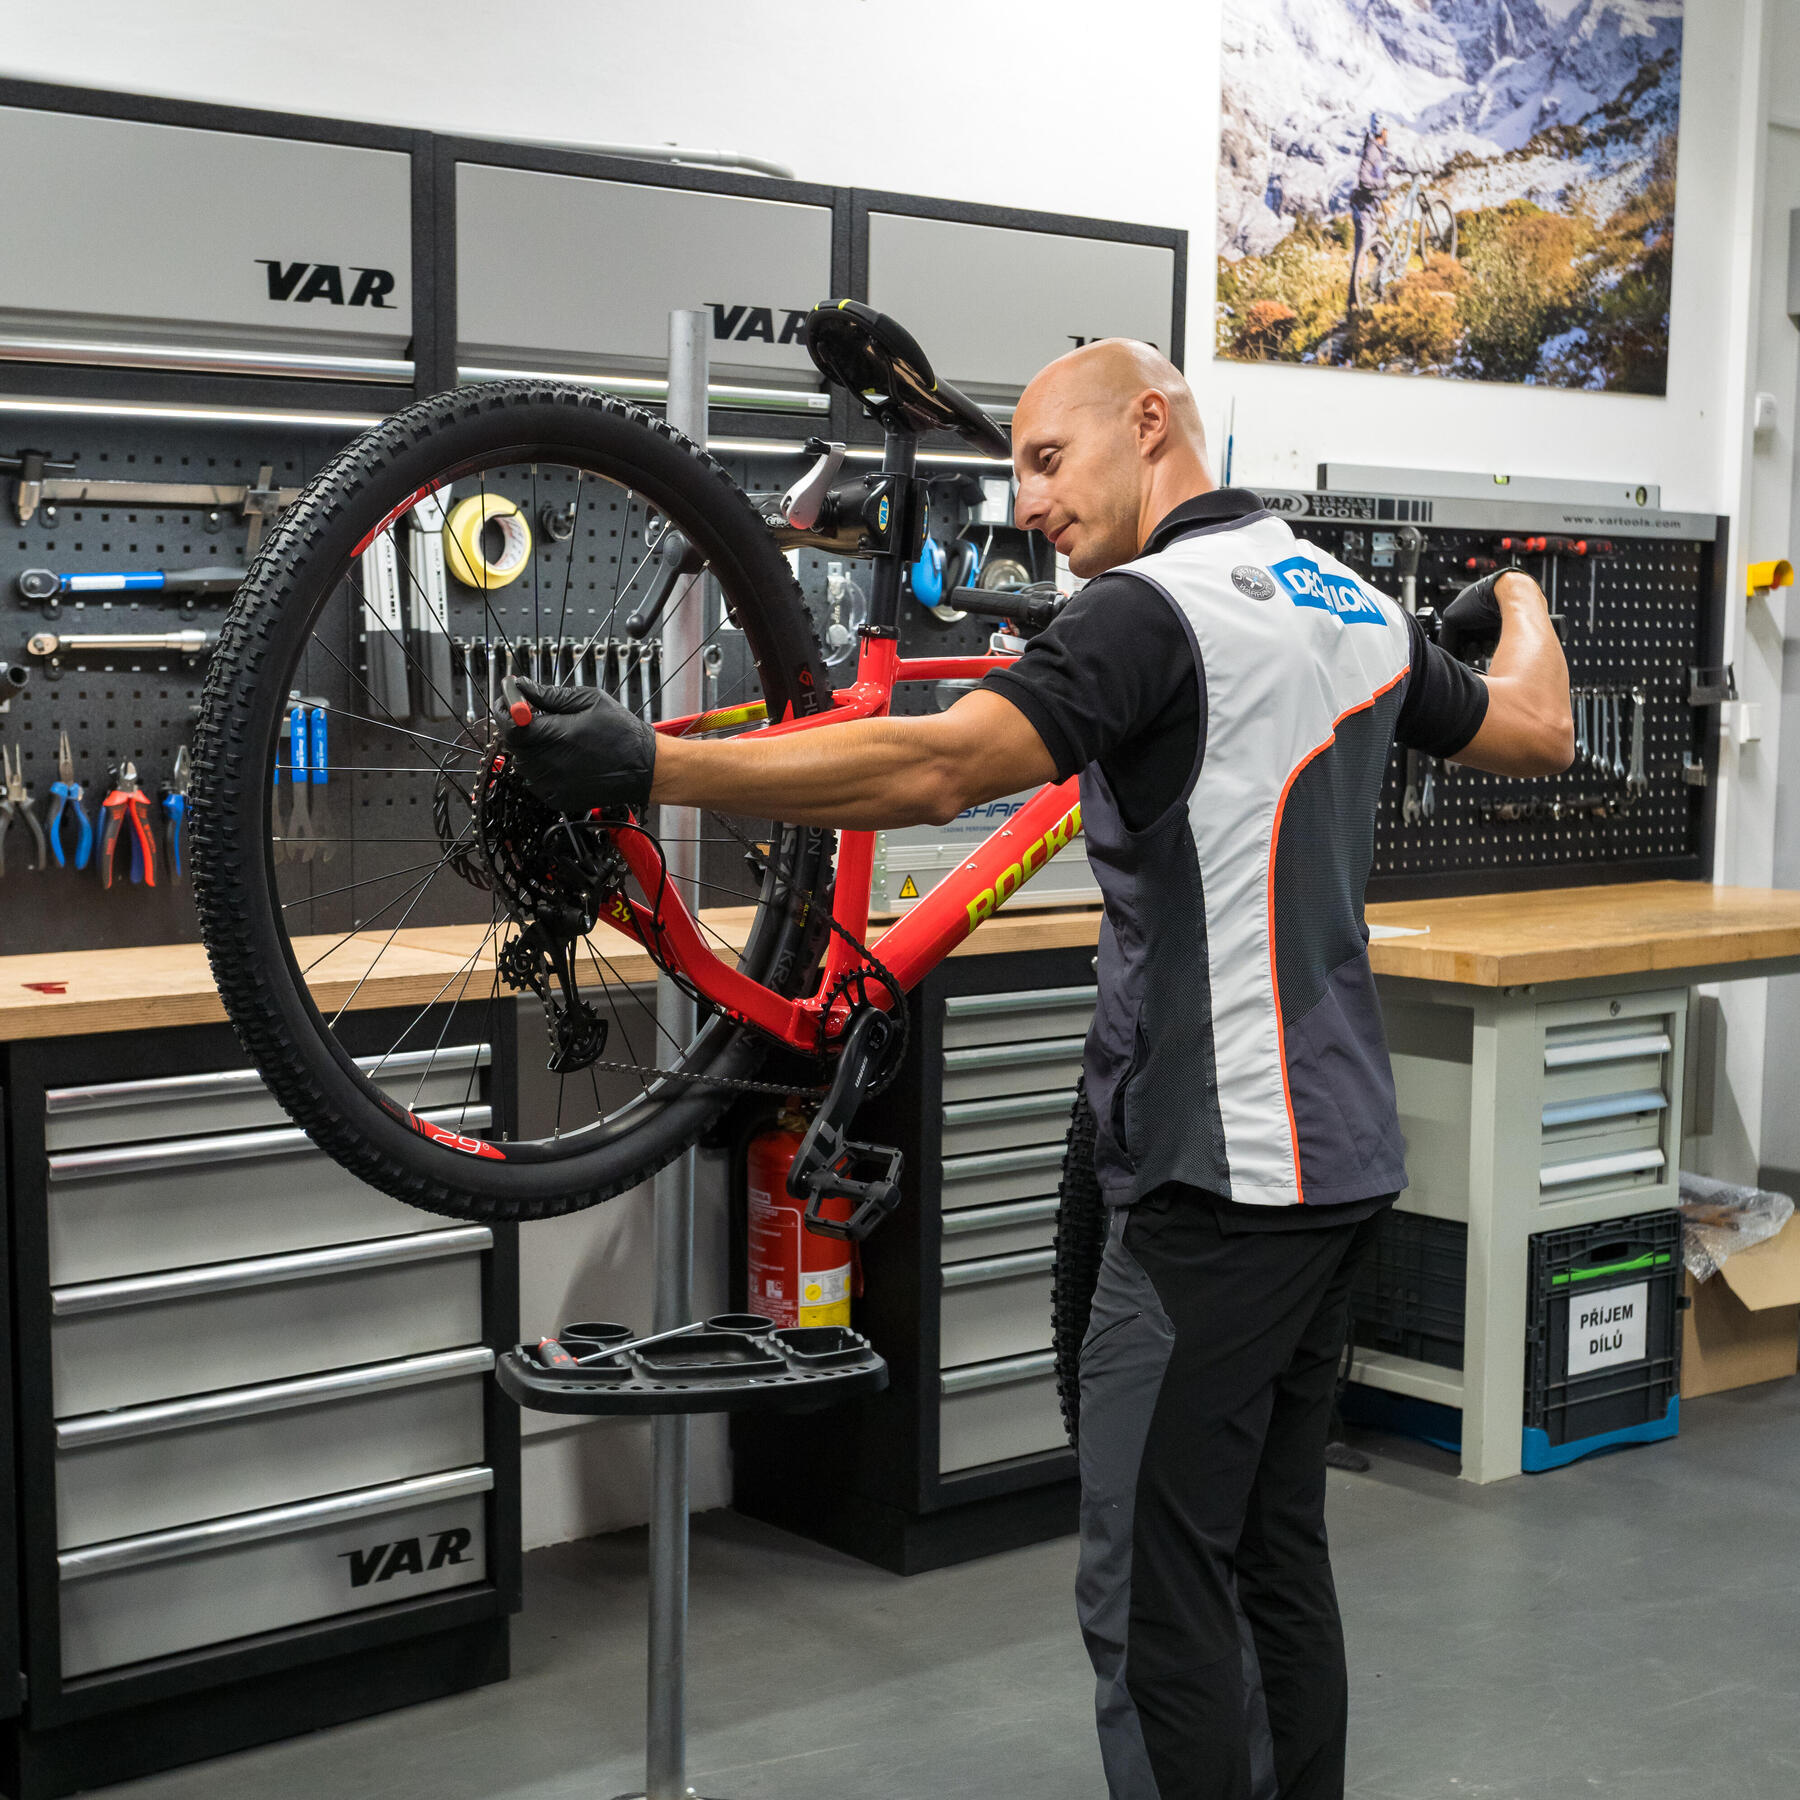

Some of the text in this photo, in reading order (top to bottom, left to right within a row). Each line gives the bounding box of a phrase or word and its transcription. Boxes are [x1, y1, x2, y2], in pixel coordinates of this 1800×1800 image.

[253, 259, 398, 309] VAR
[703, 302, 810, 346] VAR
[1262, 496, 1293, 512] VAR
[1313, 507, 1373, 520] TOOLS
[1562, 515, 1681, 529] www.vartools.com
[611, 900, 631, 922] 29
[432, 1127, 481, 1154] 29
[1580, 1303, 1634, 1330] PŘÍJEM
[1589, 1329, 1623, 1355] DÍLŮ
[337, 1527, 474, 1588] VAR
